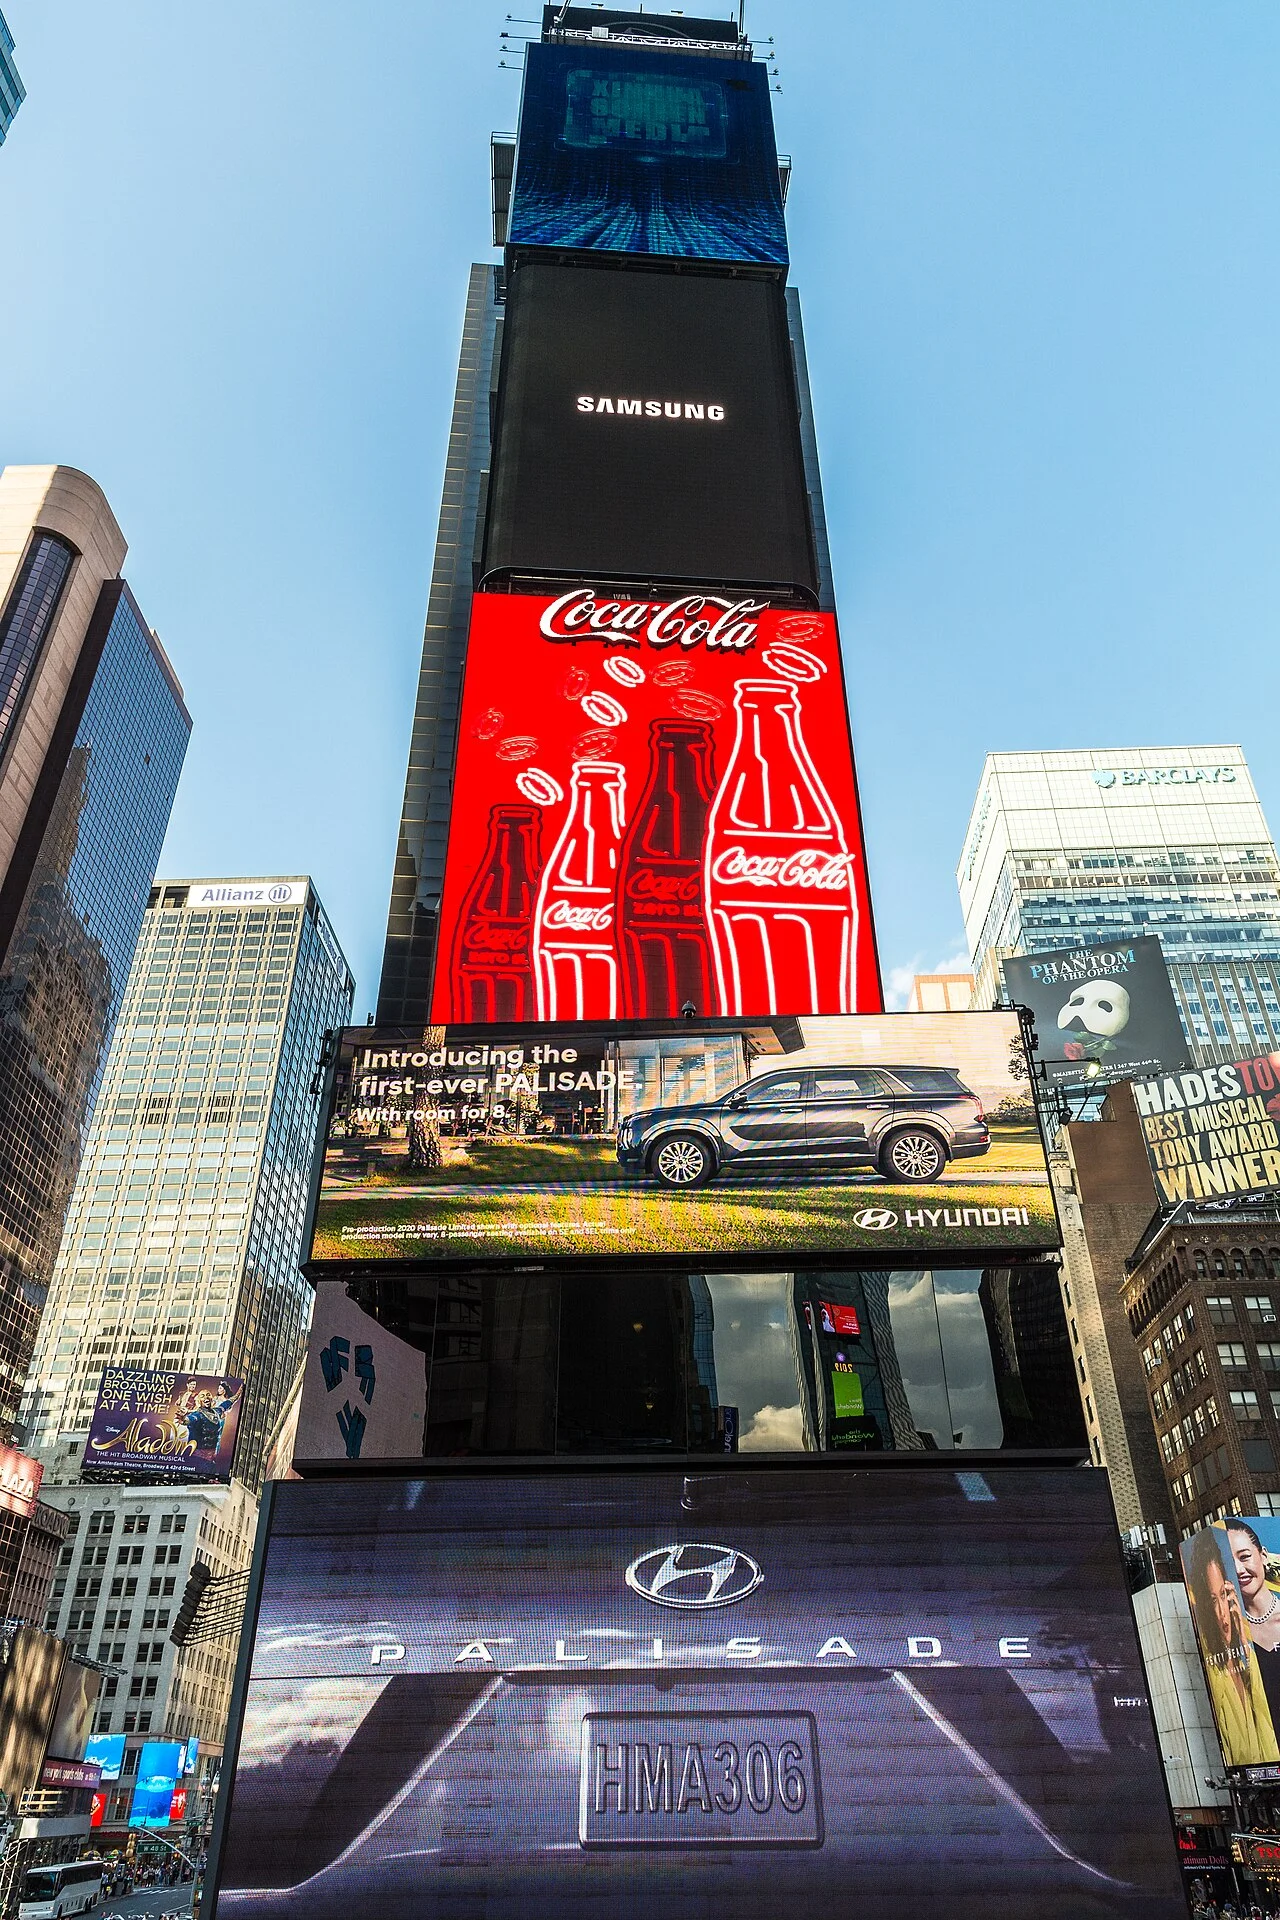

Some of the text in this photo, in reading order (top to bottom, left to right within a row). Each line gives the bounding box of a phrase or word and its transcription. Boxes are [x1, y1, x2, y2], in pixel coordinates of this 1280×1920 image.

[577, 396, 725, 421] SAMSUNG
[539, 588, 770, 648] Coca-Cola
[1122, 767, 1236, 785] BARCLAYS
[712, 846, 855, 891] Coca-Cola
[201, 888, 264, 901] Allianz
[1030, 949, 1136, 979] PHANTOM
[1066, 949, 1094, 960] THE
[1042, 964, 1129, 985] OF THE OPERA
[363, 1044, 578, 1069] Introducing the
[359, 1070, 643, 1097] first-ever PALISADE.
[356, 1104, 511, 1122] With room for 8.
[1143, 1095, 1271, 1143] BEST MUSICAL
[1150, 1121, 1279, 1169] TONY AWARD
[904, 1207, 1030, 1228] HYUNDAI
[341, 1232, 380, 1241] production
[406, 1232, 421, 1240] may
[397, 1224, 415, 1232] 2020
[417, 1223, 447, 1231] Palisade
[103, 1379, 174, 1393] BROADWAY
[106, 1369, 176, 1385] DAZZLING
[99, 1400, 118, 1411] AT
[120, 1401, 131, 1412] A
[101, 1389, 173, 1404] ONE WISH
[91, 1417, 198, 1457] Aladdin
[105, 1425, 121, 1435] Disney
[121, 1453, 158, 1461] BROADWAY
[370, 1636, 1032, 1665] PALISADE
[595, 1740, 808, 1815] HMA306
[1208, 1855, 1229, 1865] Dolls
